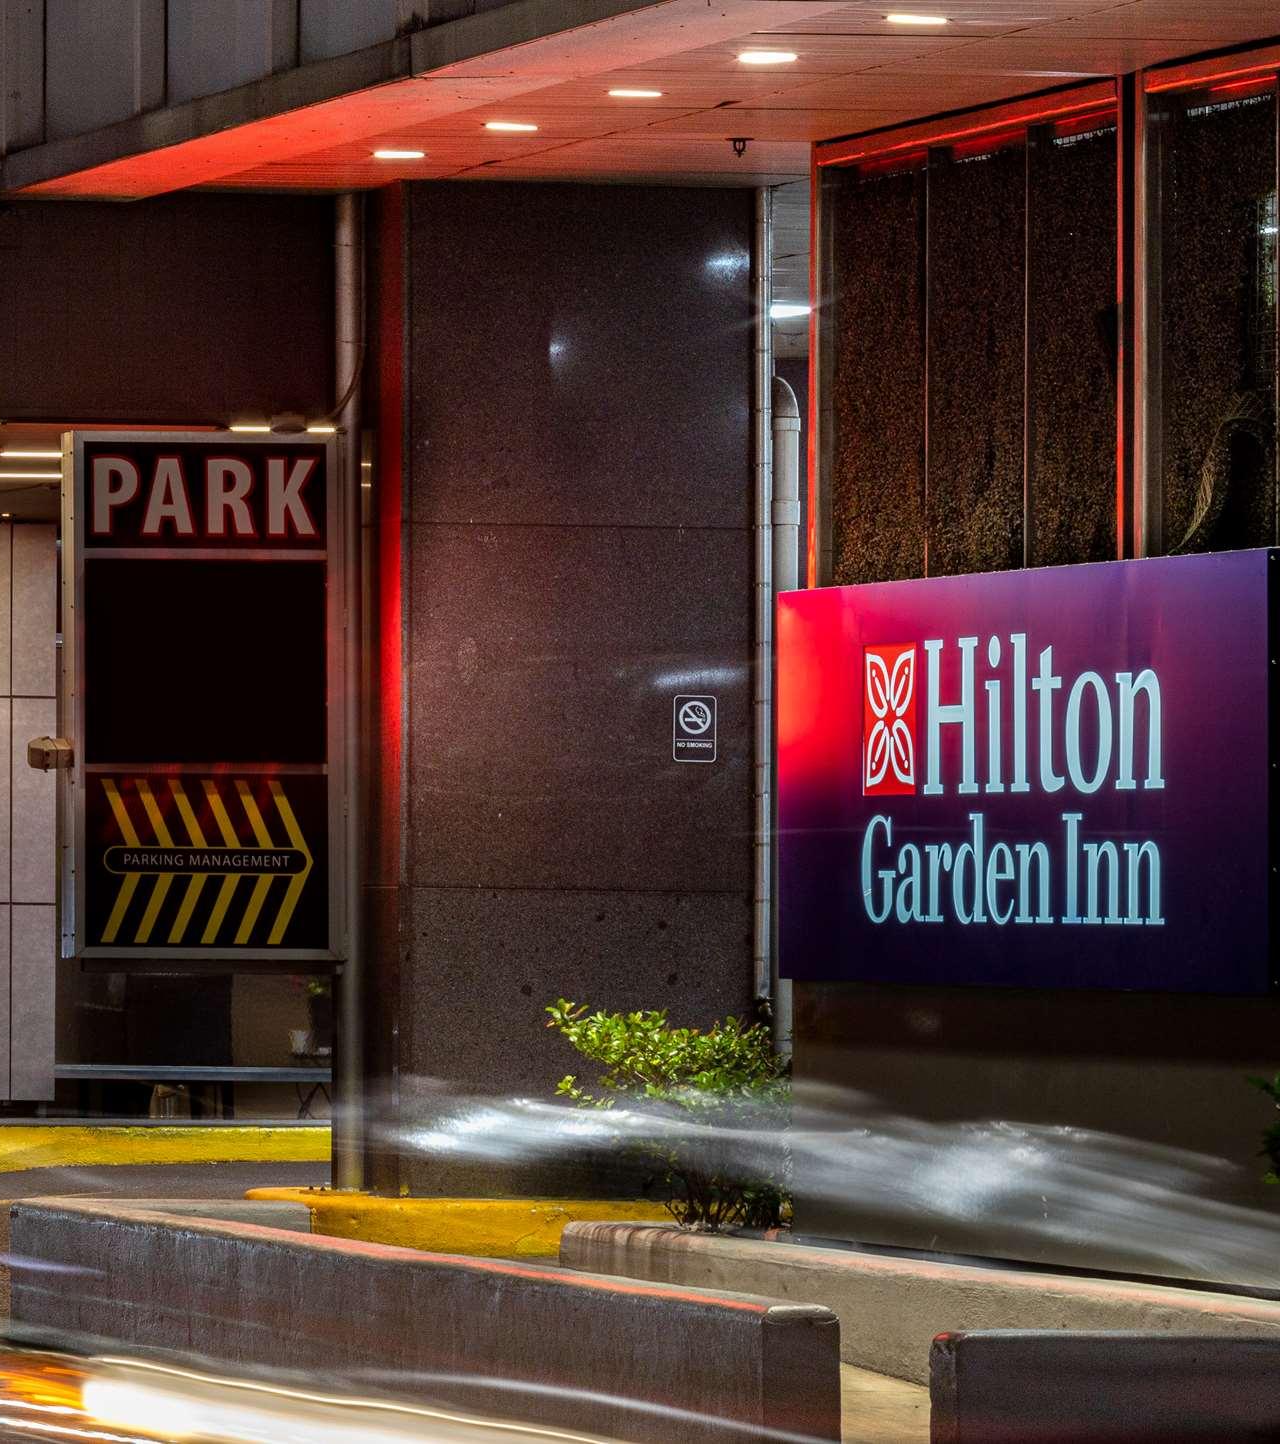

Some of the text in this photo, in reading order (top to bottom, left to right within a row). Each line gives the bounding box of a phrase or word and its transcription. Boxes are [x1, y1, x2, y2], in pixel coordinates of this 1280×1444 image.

[91, 455, 318, 537] PARK
[923, 633, 1166, 796] Hilton
[123, 853, 291, 869] PARKING MANAGEMENT
[862, 812, 1166, 926] Garden Inn
